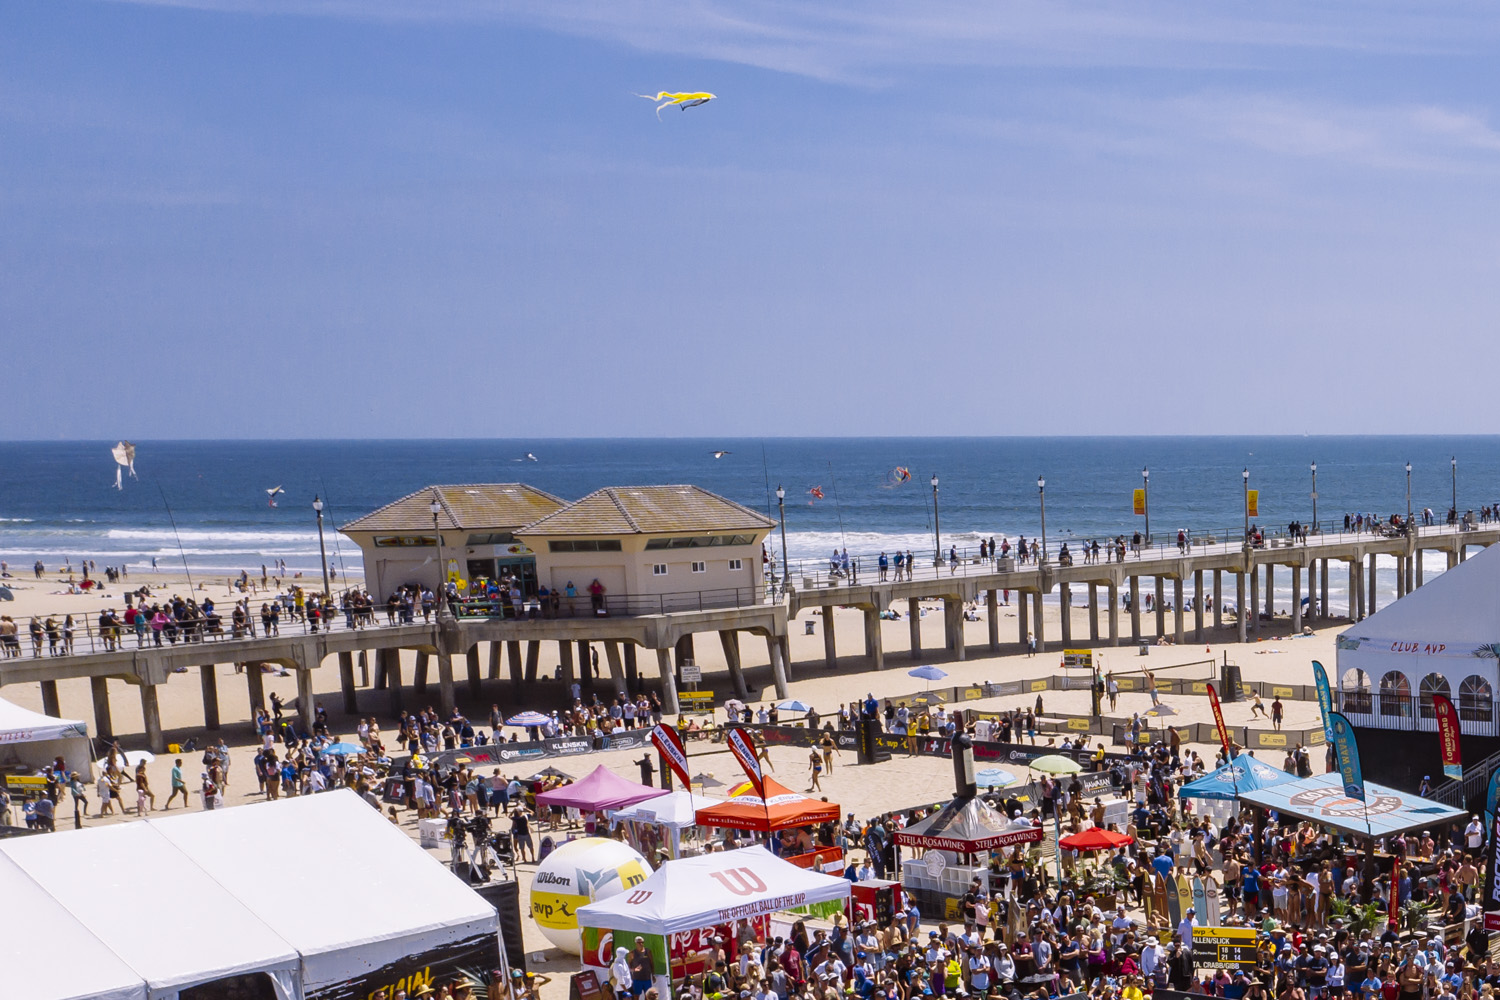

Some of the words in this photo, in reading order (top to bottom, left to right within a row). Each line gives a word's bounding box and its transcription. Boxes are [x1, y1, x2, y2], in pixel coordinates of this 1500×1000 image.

[1391, 641, 1419, 653] CLUB
[1424, 643, 1446, 656] AVP
[552, 741, 588, 750] KLENSKIN
[1440, 717, 1452, 761] LONGBOARD
[657, 730, 684, 767] KLENSKIN
[732, 734, 758, 770] KLENSKIN
[1337, 737, 1351, 767] WAVE
[898, 833, 923, 846] STELLA
[923, 837, 940, 848] ROSA
[940, 839, 965, 851] WINES
[975, 837, 998, 849] STELLA
[999, 834, 1015, 846] ROSA
[1015, 831, 1038, 843] WINES
[537, 872, 571, 886] Wilson
[534, 902, 553, 918] avp
[717, 909, 730, 921] THE
[731, 904, 758, 919] OFFICIAL
[759, 900, 773, 912] BALL
[774, 898, 782, 909] OF
[783, 896, 794, 907] THE
[795, 893, 806, 905] AVP
[1192, 937, 1230, 945] ALLEN/SLICK
